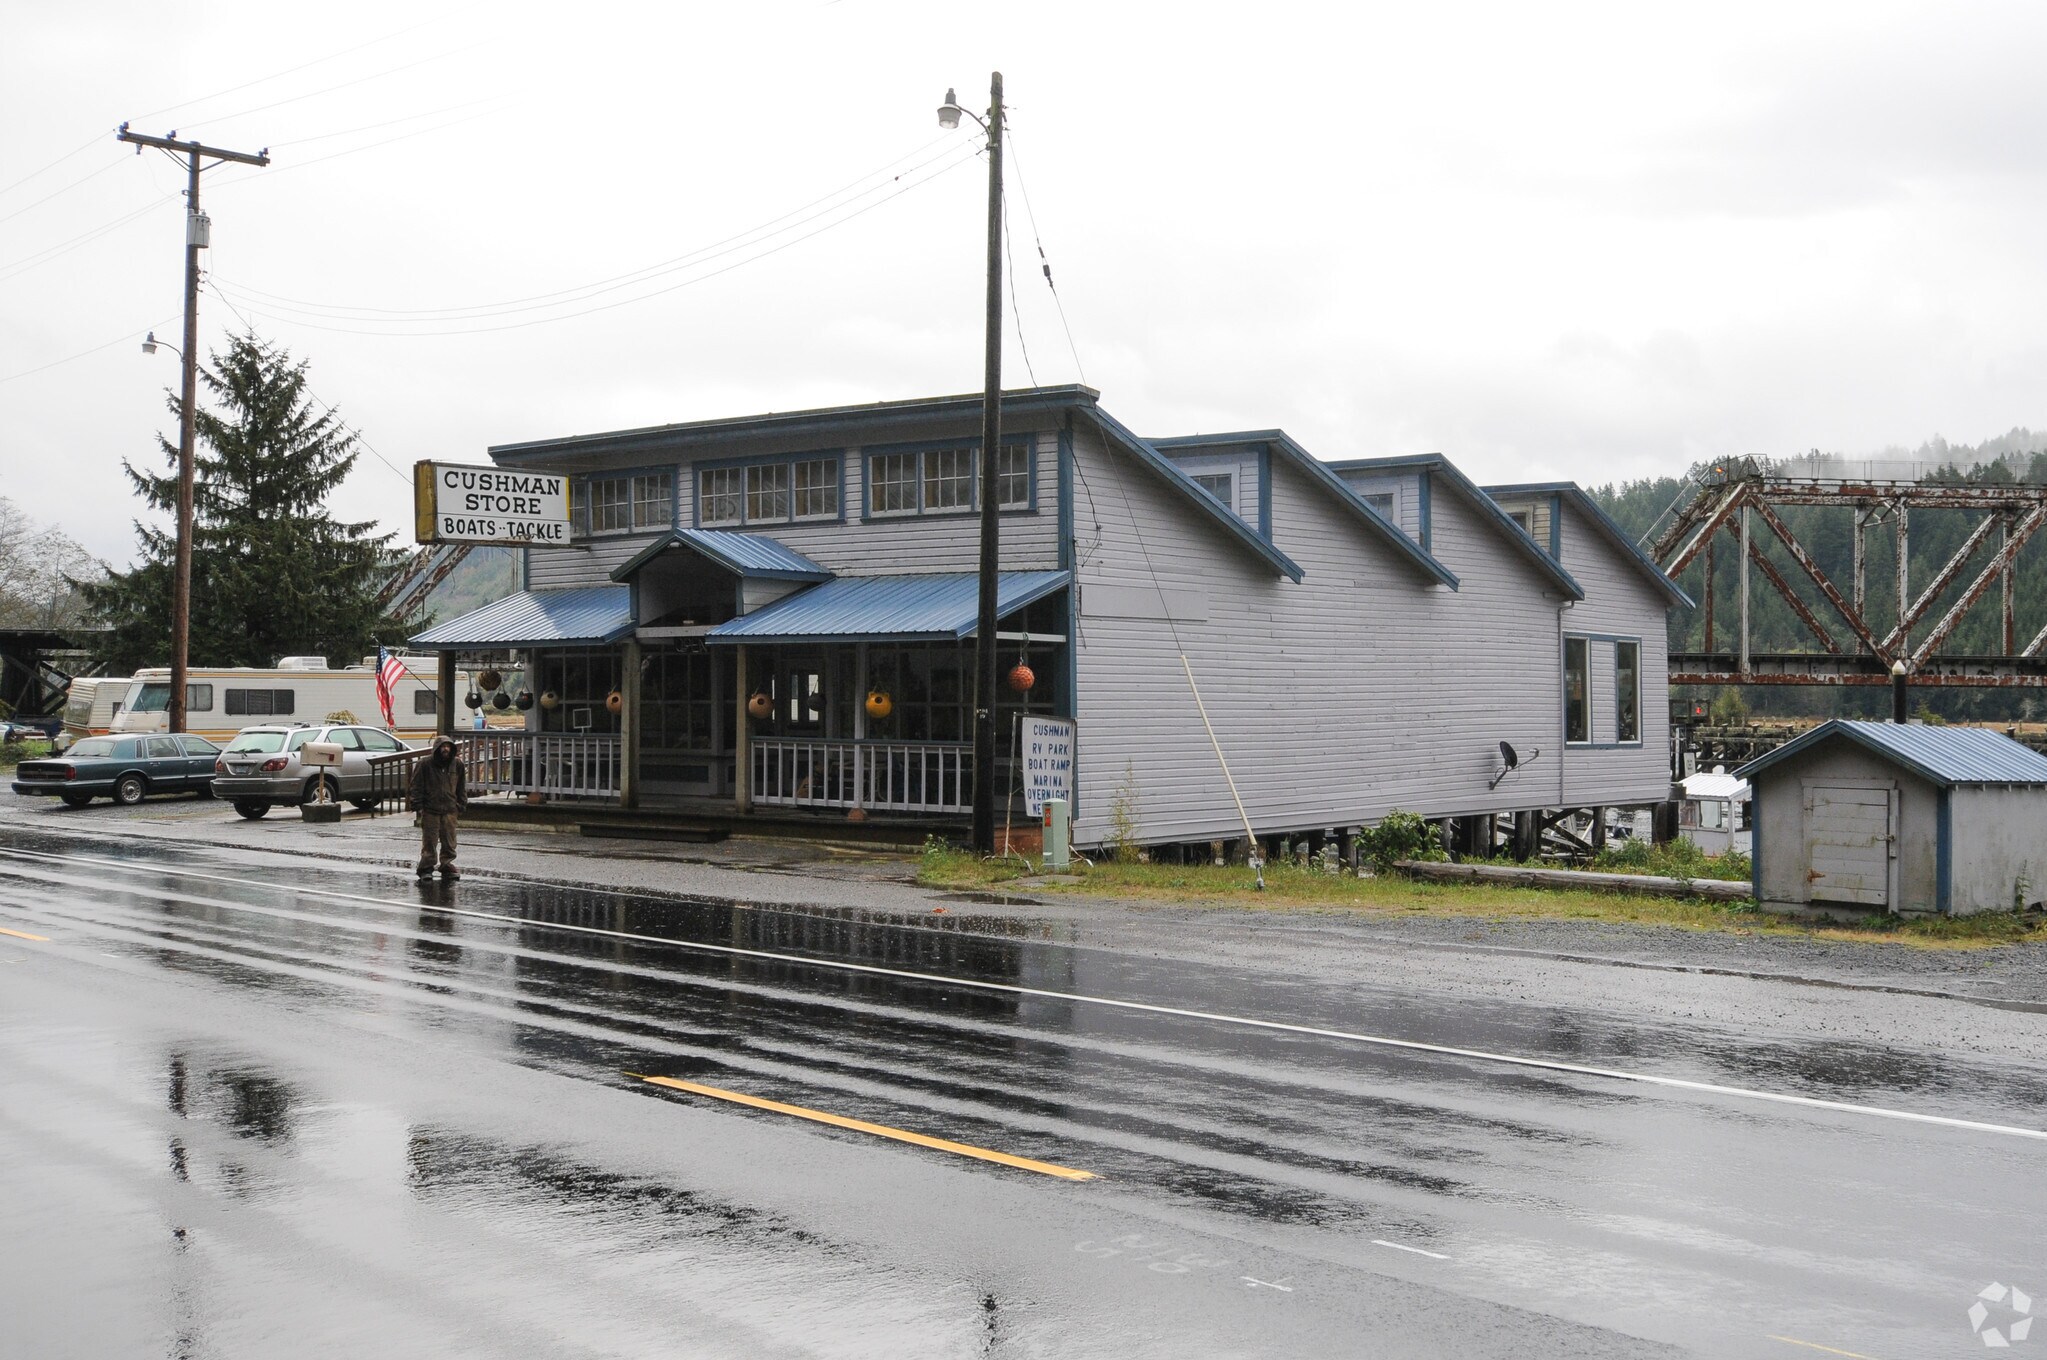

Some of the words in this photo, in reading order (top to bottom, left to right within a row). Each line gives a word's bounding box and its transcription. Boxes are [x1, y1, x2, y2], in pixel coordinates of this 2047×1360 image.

[444, 471, 561, 496] CUSHMAN
[465, 493, 541, 515] STORE
[444, 517, 496, 536] BOATS
[507, 521, 562, 540] TACKLE
[1033, 725, 1070, 737] CUSHMAN
[1032, 743, 1042, 755] RV
[1048, 743, 1069, 756] PARK
[1028, 758, 1048, 770] BOAT
[1050, 759, 1071, 771] RAMP
[1033, 775, 1062, 787] MARINA
[1027, 790, 1069, 801] OVERNIGHT
